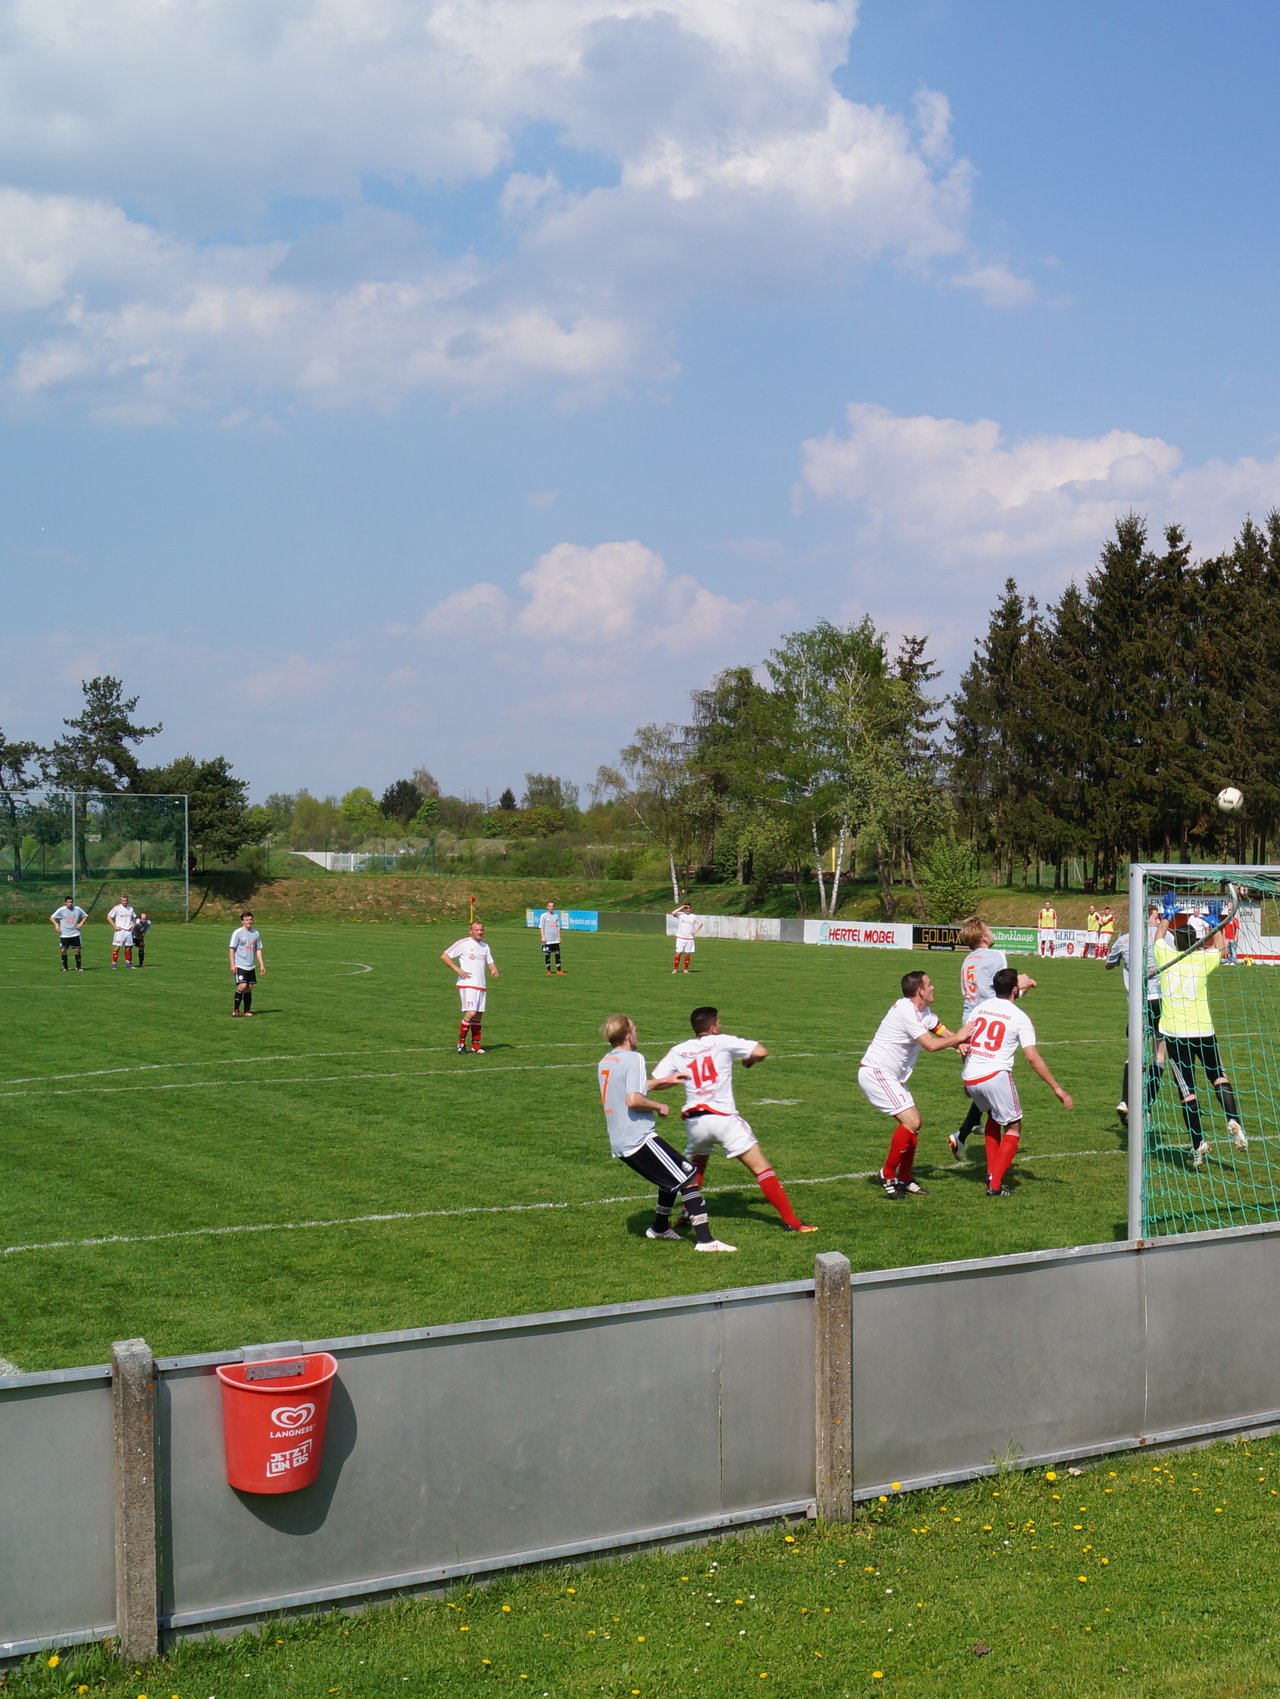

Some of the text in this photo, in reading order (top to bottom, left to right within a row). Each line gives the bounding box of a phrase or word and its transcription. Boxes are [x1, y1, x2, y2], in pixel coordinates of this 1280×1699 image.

[1150, 899, 1189, 908] EINCHT
[828, 928, 861, 942] HERTEL
[922, 928, 962, 944] GOLDAX
[1054, 930, 1075, 941] GEREI
[970, 1016, 1006, 1052] 29
[686, 1055, 719, 1089] 14
[600, 1069, 612, 1105] 7
[269, 1425, 314, 1439] LANGNESE
[270, 1443, 310, 1463] JETZT
[271, 1453, 309, 1473] EIN EIS
